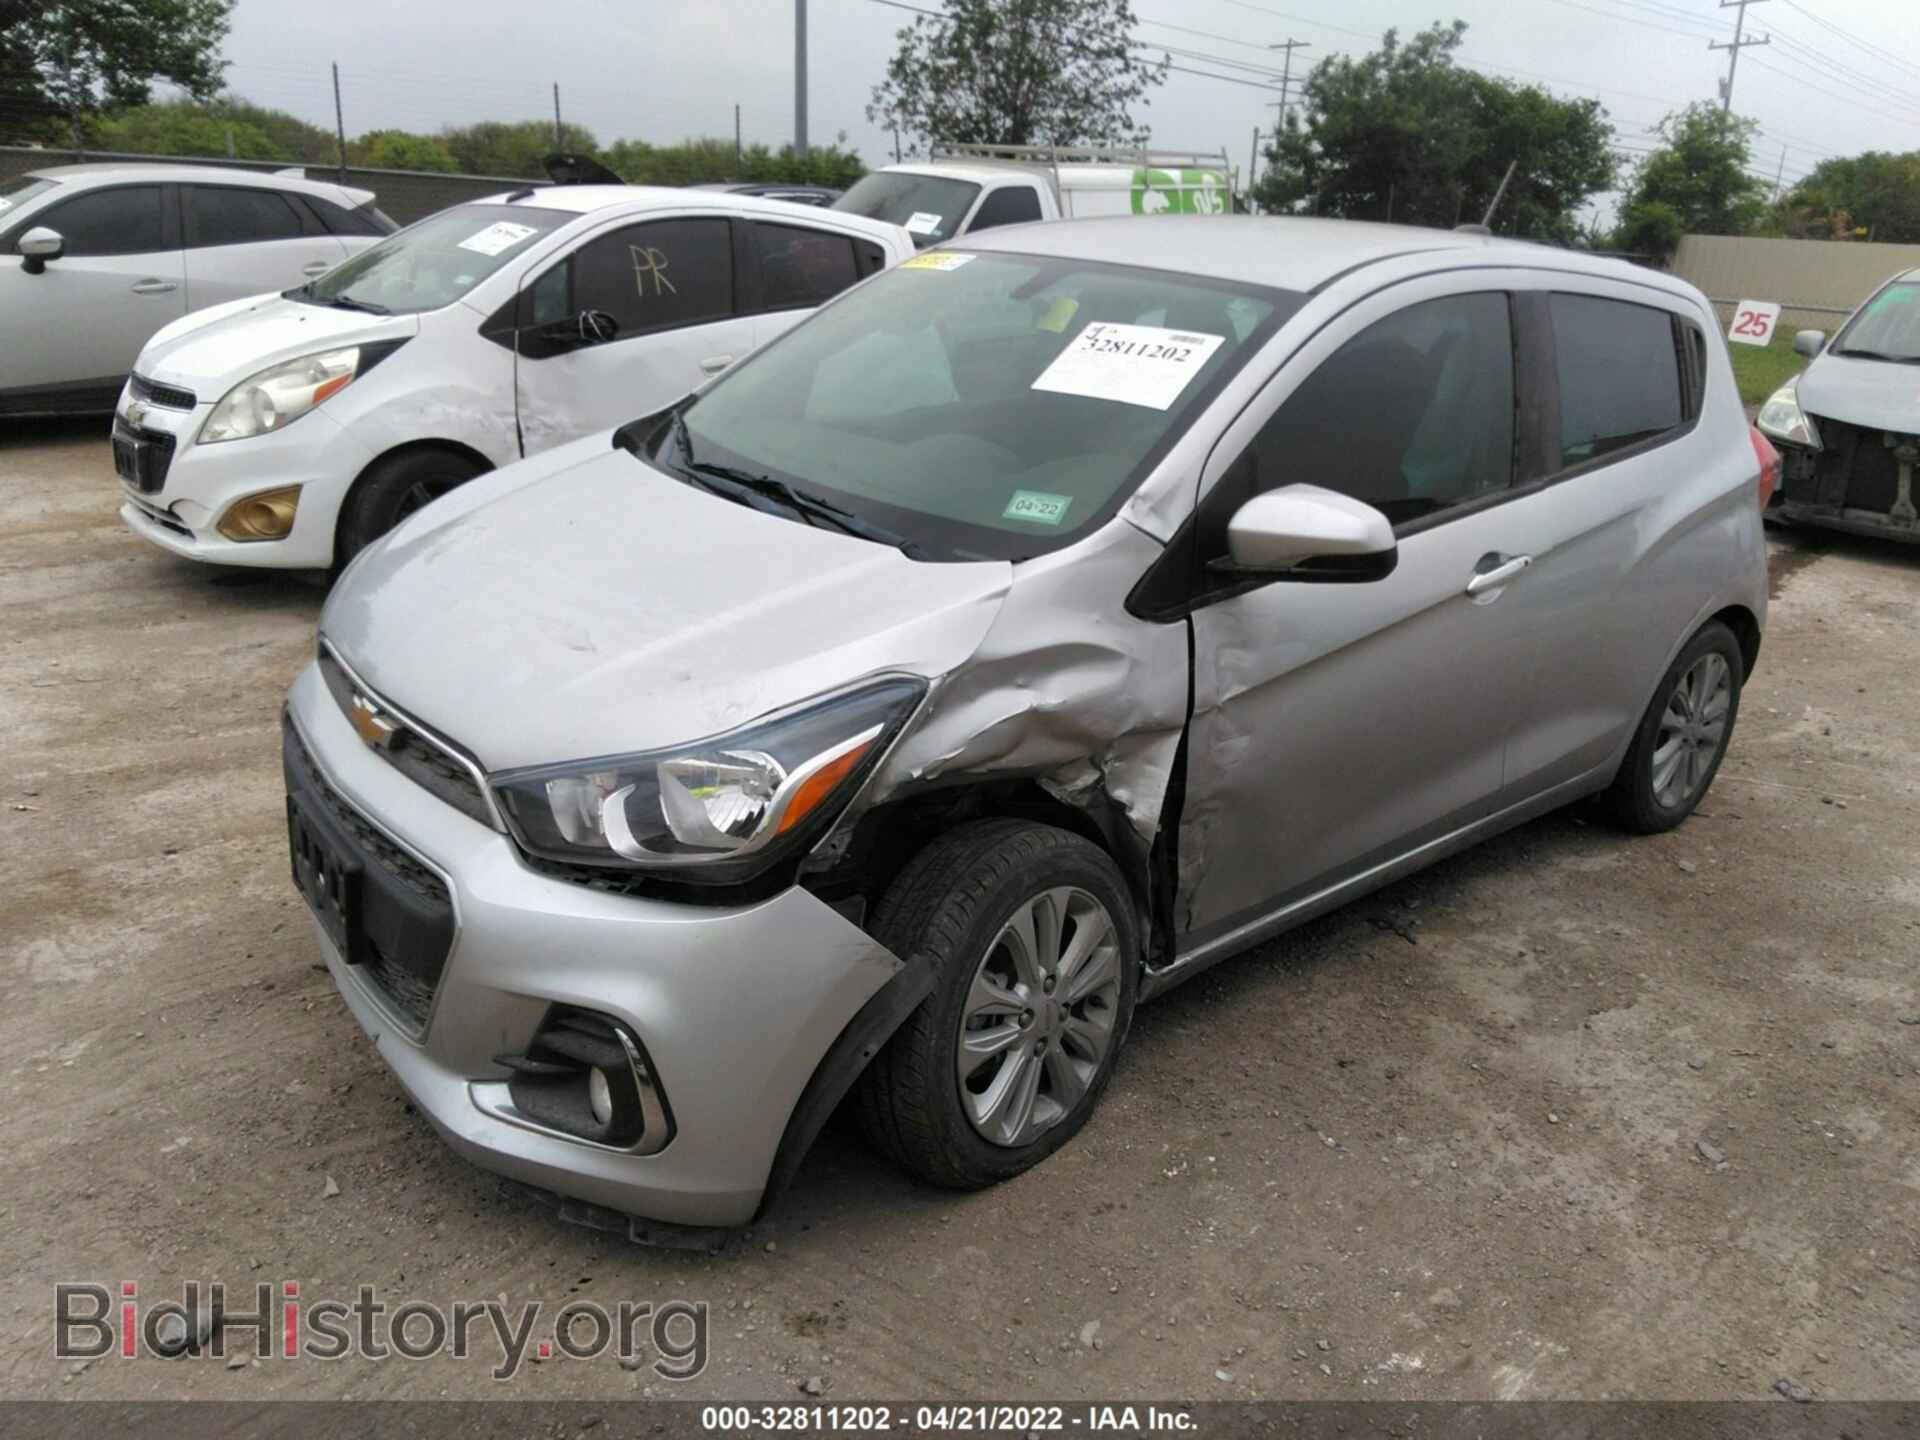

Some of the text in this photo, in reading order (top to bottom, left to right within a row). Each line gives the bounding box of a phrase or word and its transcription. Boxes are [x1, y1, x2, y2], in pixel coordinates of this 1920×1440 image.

[629, 245, 677, 296] PR
[1734, 310, 1771, 337] 25
[1081, 338, 1191, 363] 32811202
